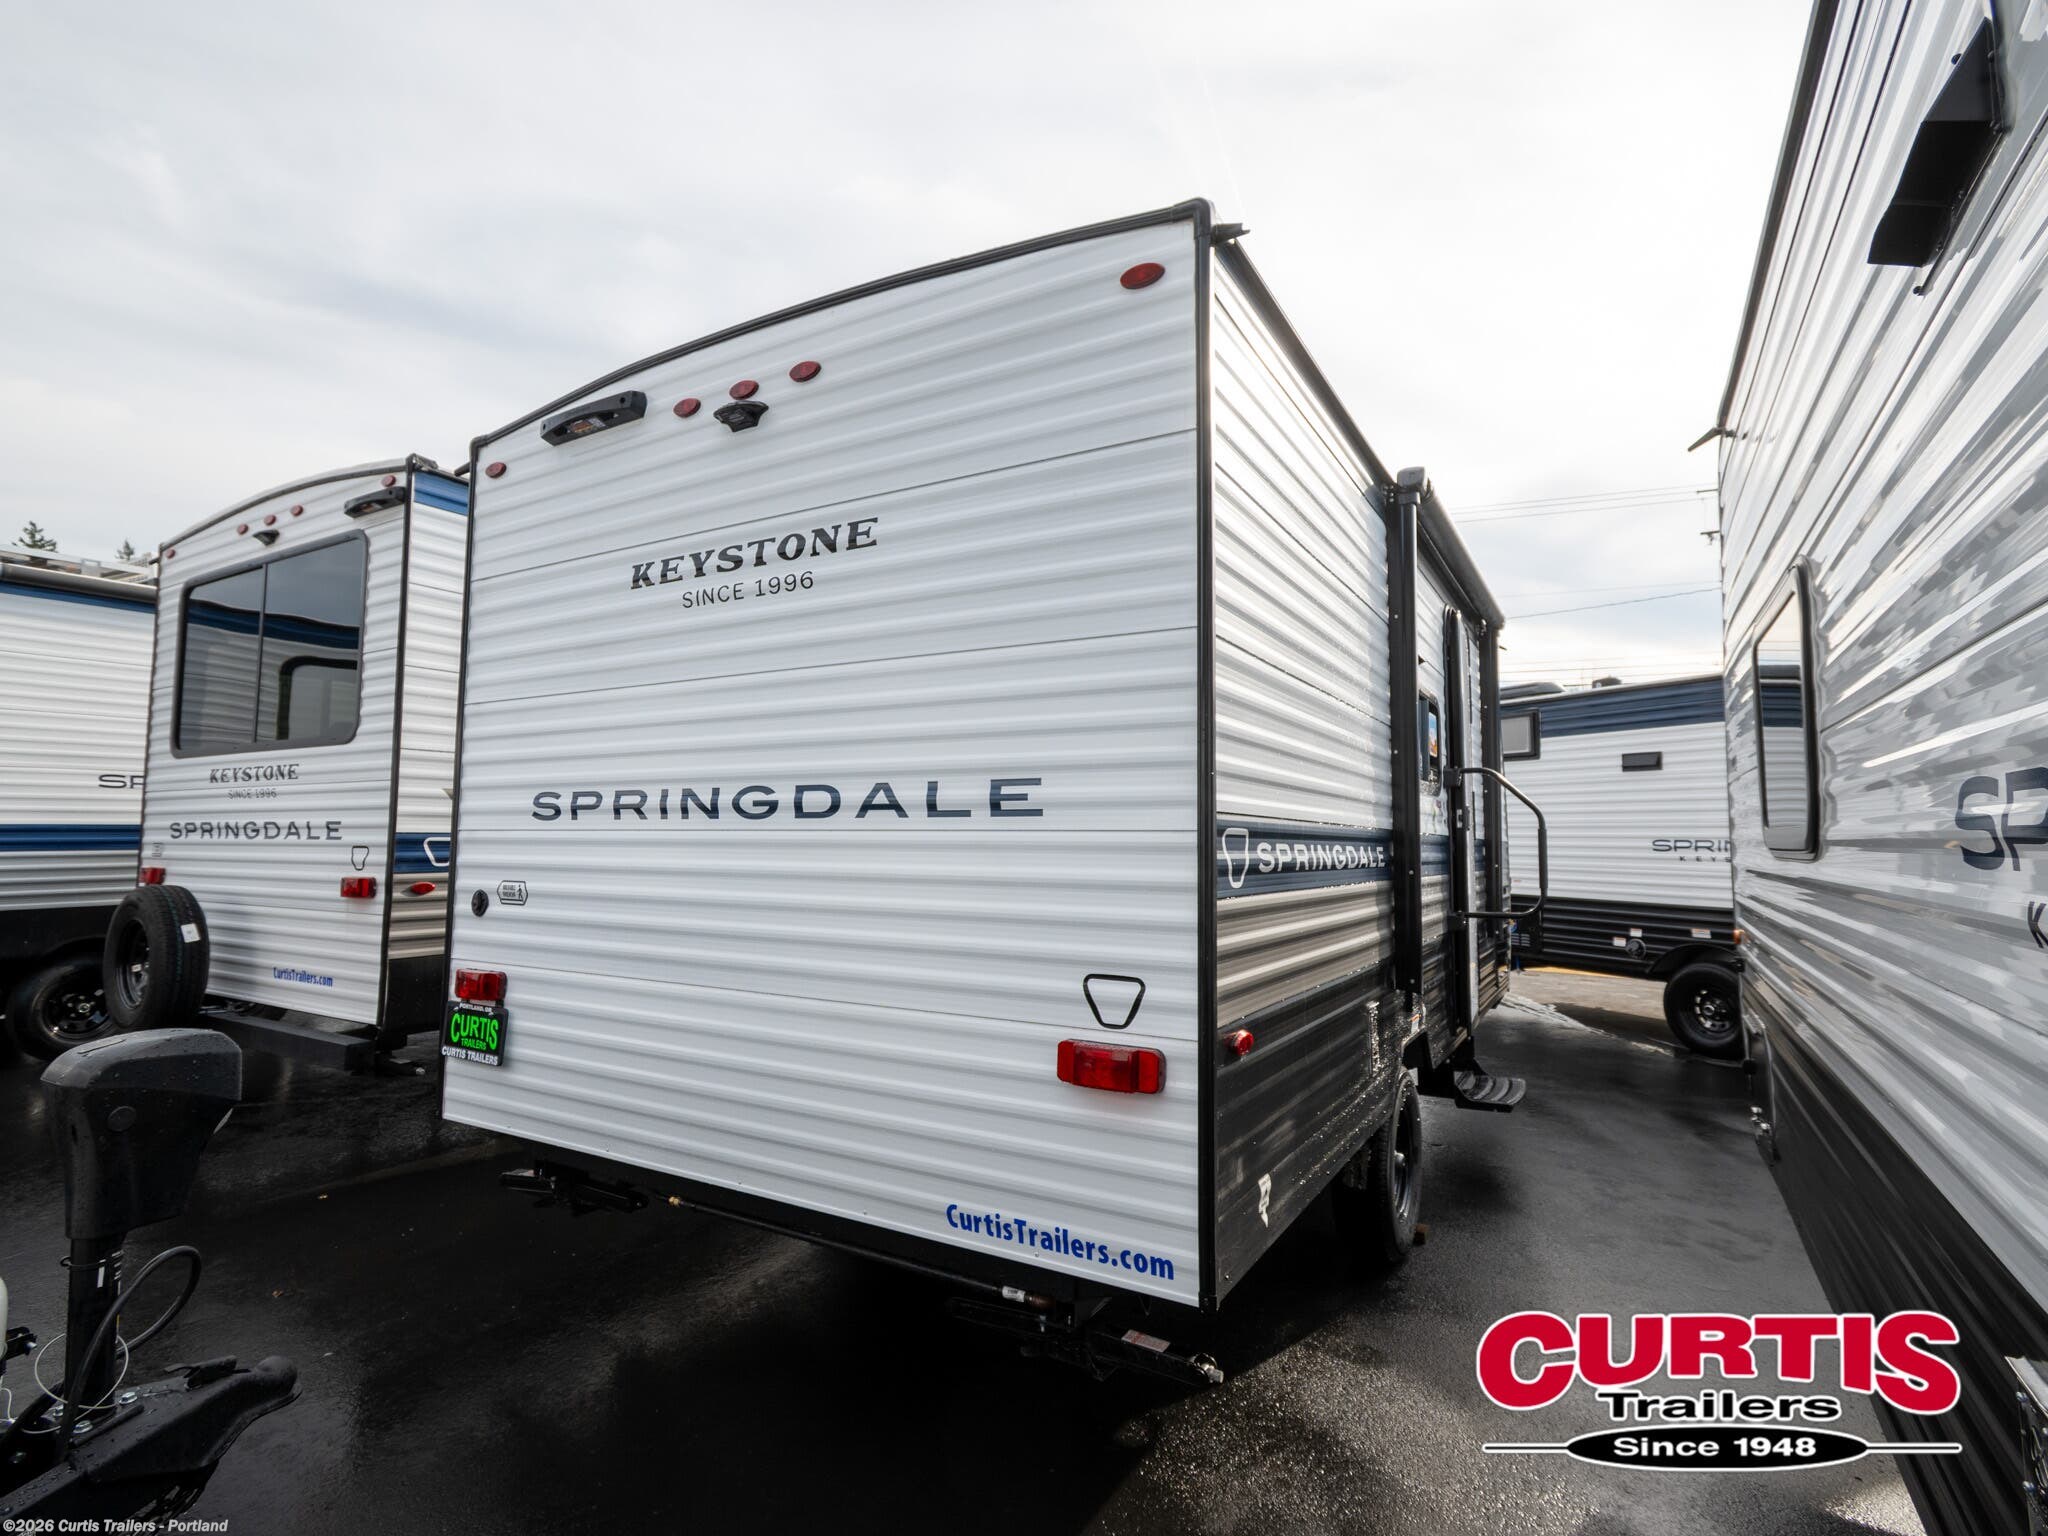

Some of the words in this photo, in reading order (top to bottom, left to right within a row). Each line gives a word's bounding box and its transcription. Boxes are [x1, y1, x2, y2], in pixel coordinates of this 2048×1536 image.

[630, 517, 879, 590] KEYSTONE
[682, 582, 745, 609] SINCE
[755, 571, 814, 597] 1996
[209, 763, 300, 784] KEYSTONE
[531, 777, 1044, 821] SPRINGDALE
[170, 821, 343, 841] SPRINGDALE
[1256, 842, 1386, 873] SPRINGDALE
[273, 967, 333, 986] CurtisTrailers.com
[451, 1013, 499, 1050] CURTIS
[461, 1038, 487, 1050] TRAILERS
[441, 1046, 466, 1059] CURTIS
[467, 1051, 498, 1066] TRAILERS
[946, 1204, 1175, 1280] CurtisTrailers.com
